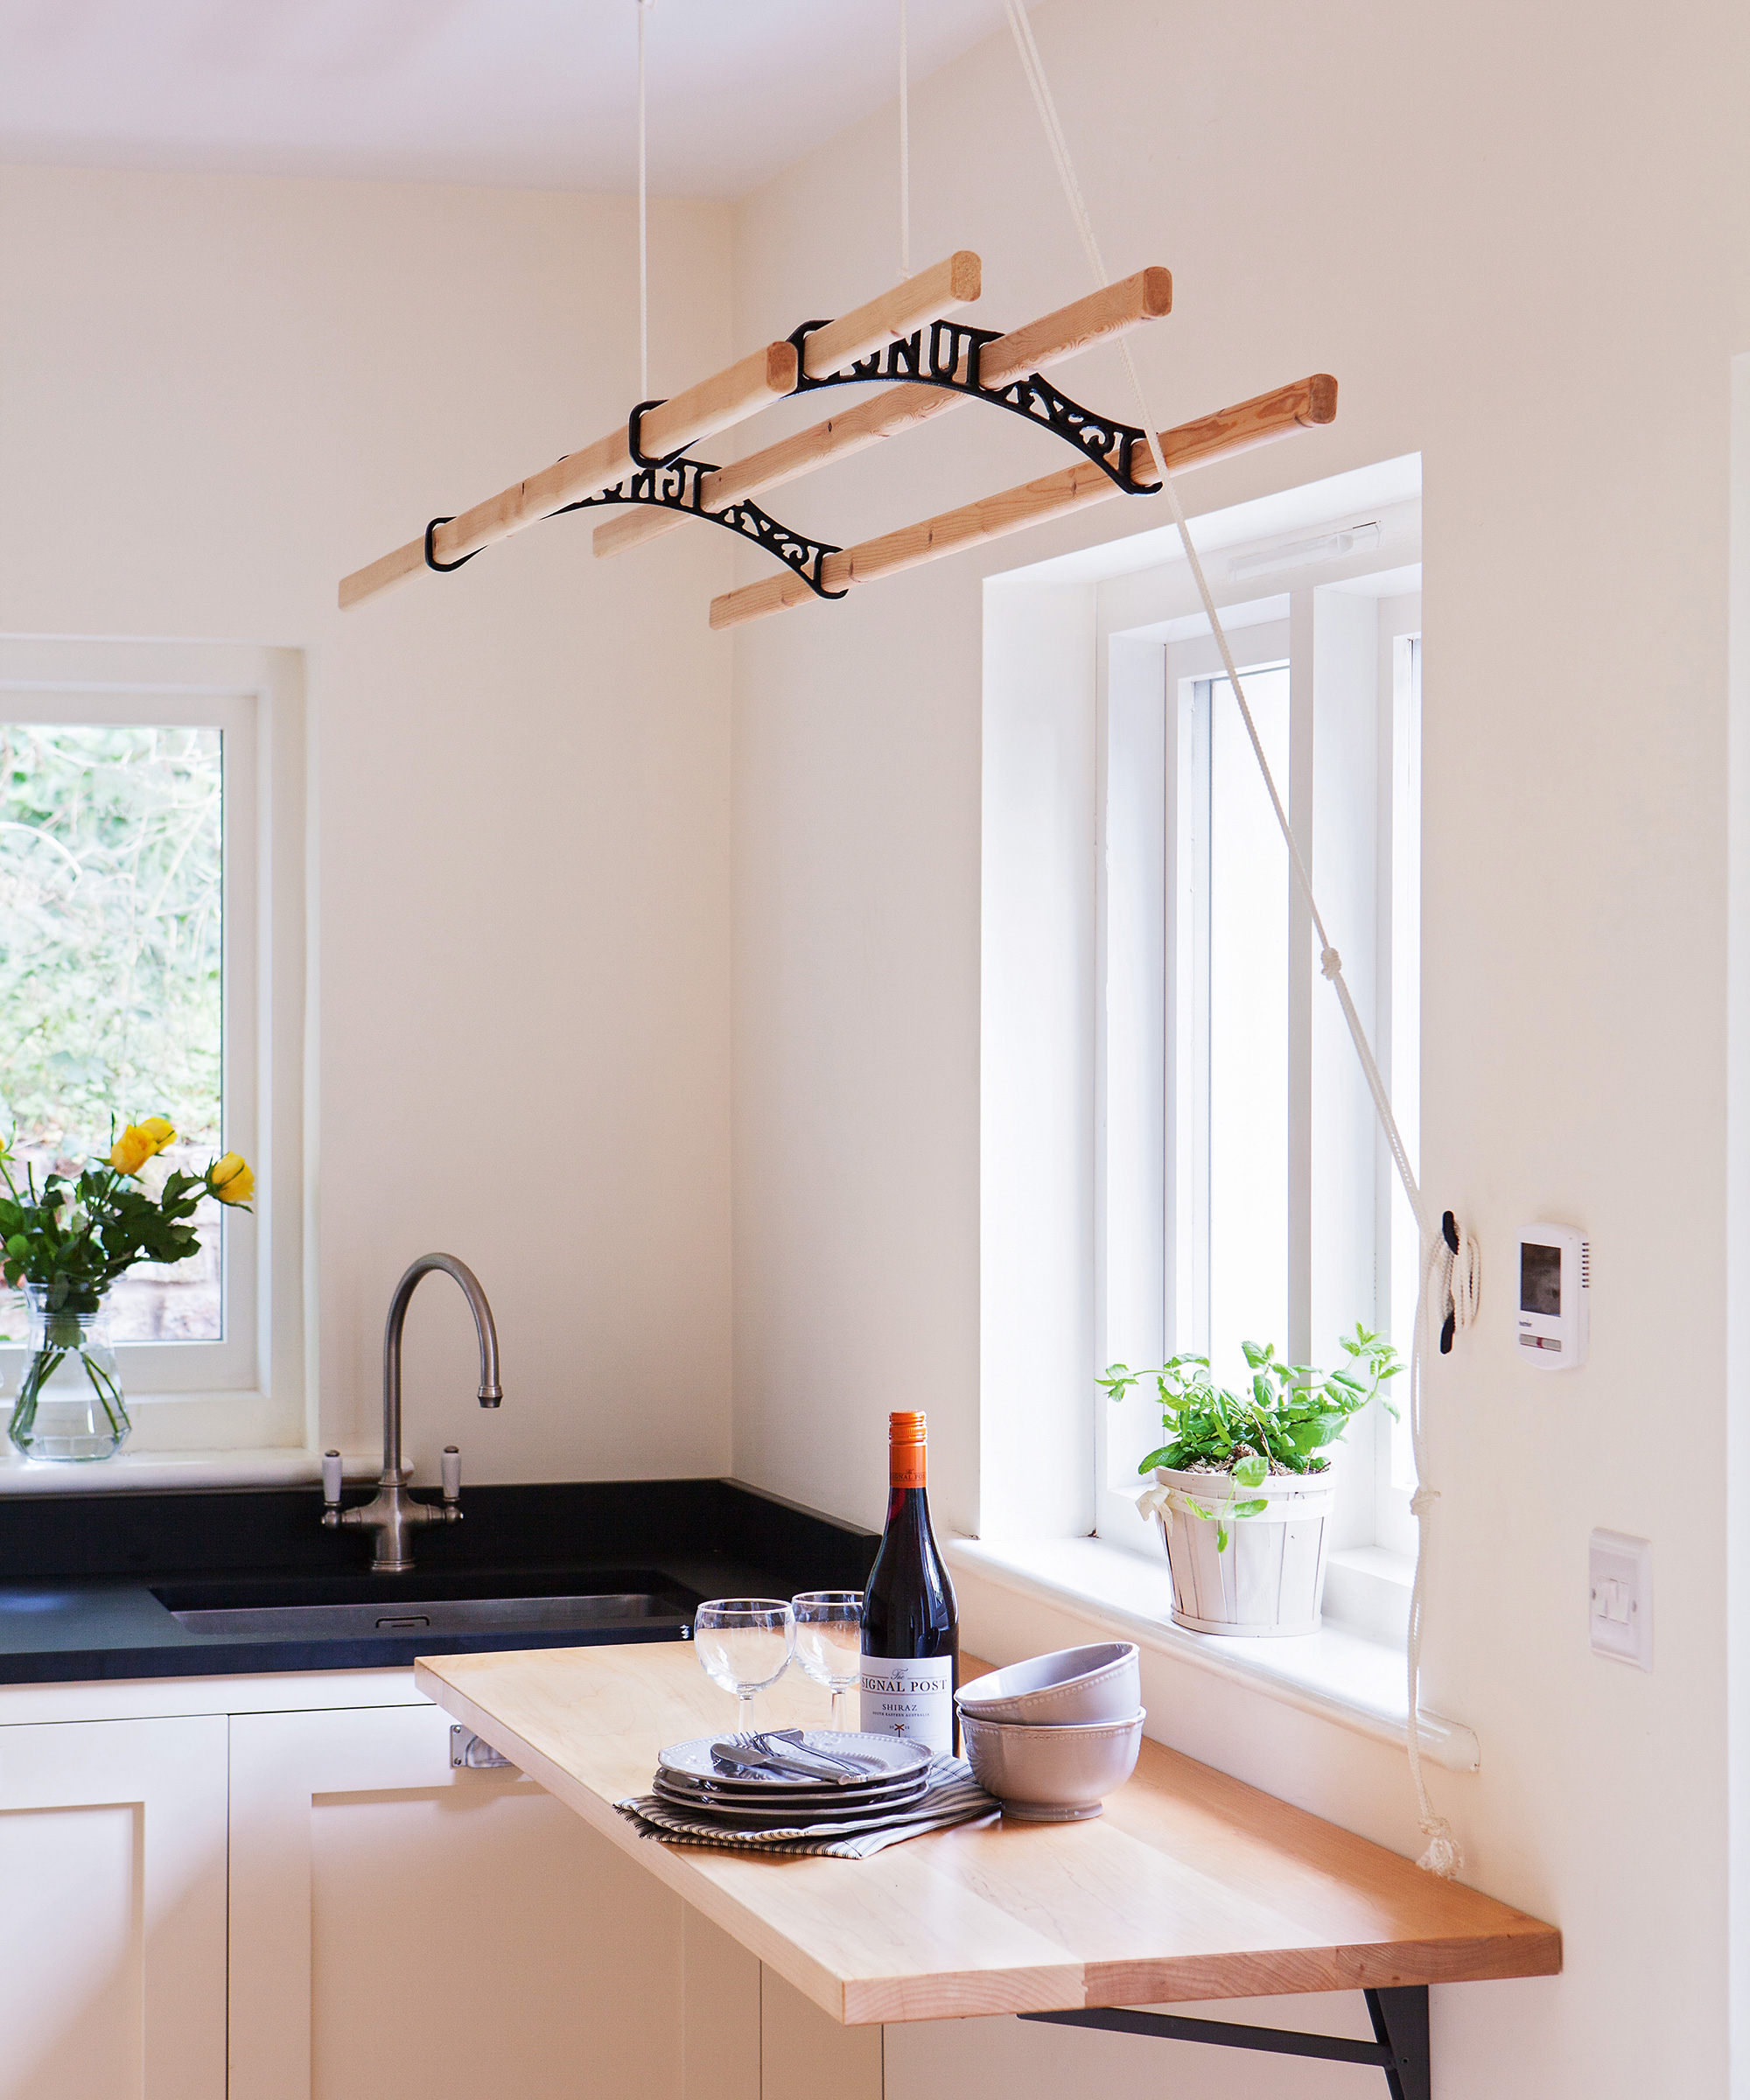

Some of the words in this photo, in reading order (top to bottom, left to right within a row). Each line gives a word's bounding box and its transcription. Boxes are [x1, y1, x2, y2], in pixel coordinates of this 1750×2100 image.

[890, 1668, 909, 1680] The
[861, 1676, 906, 1692] SIGNAL
[910, 1679, 948, 1692] POST
